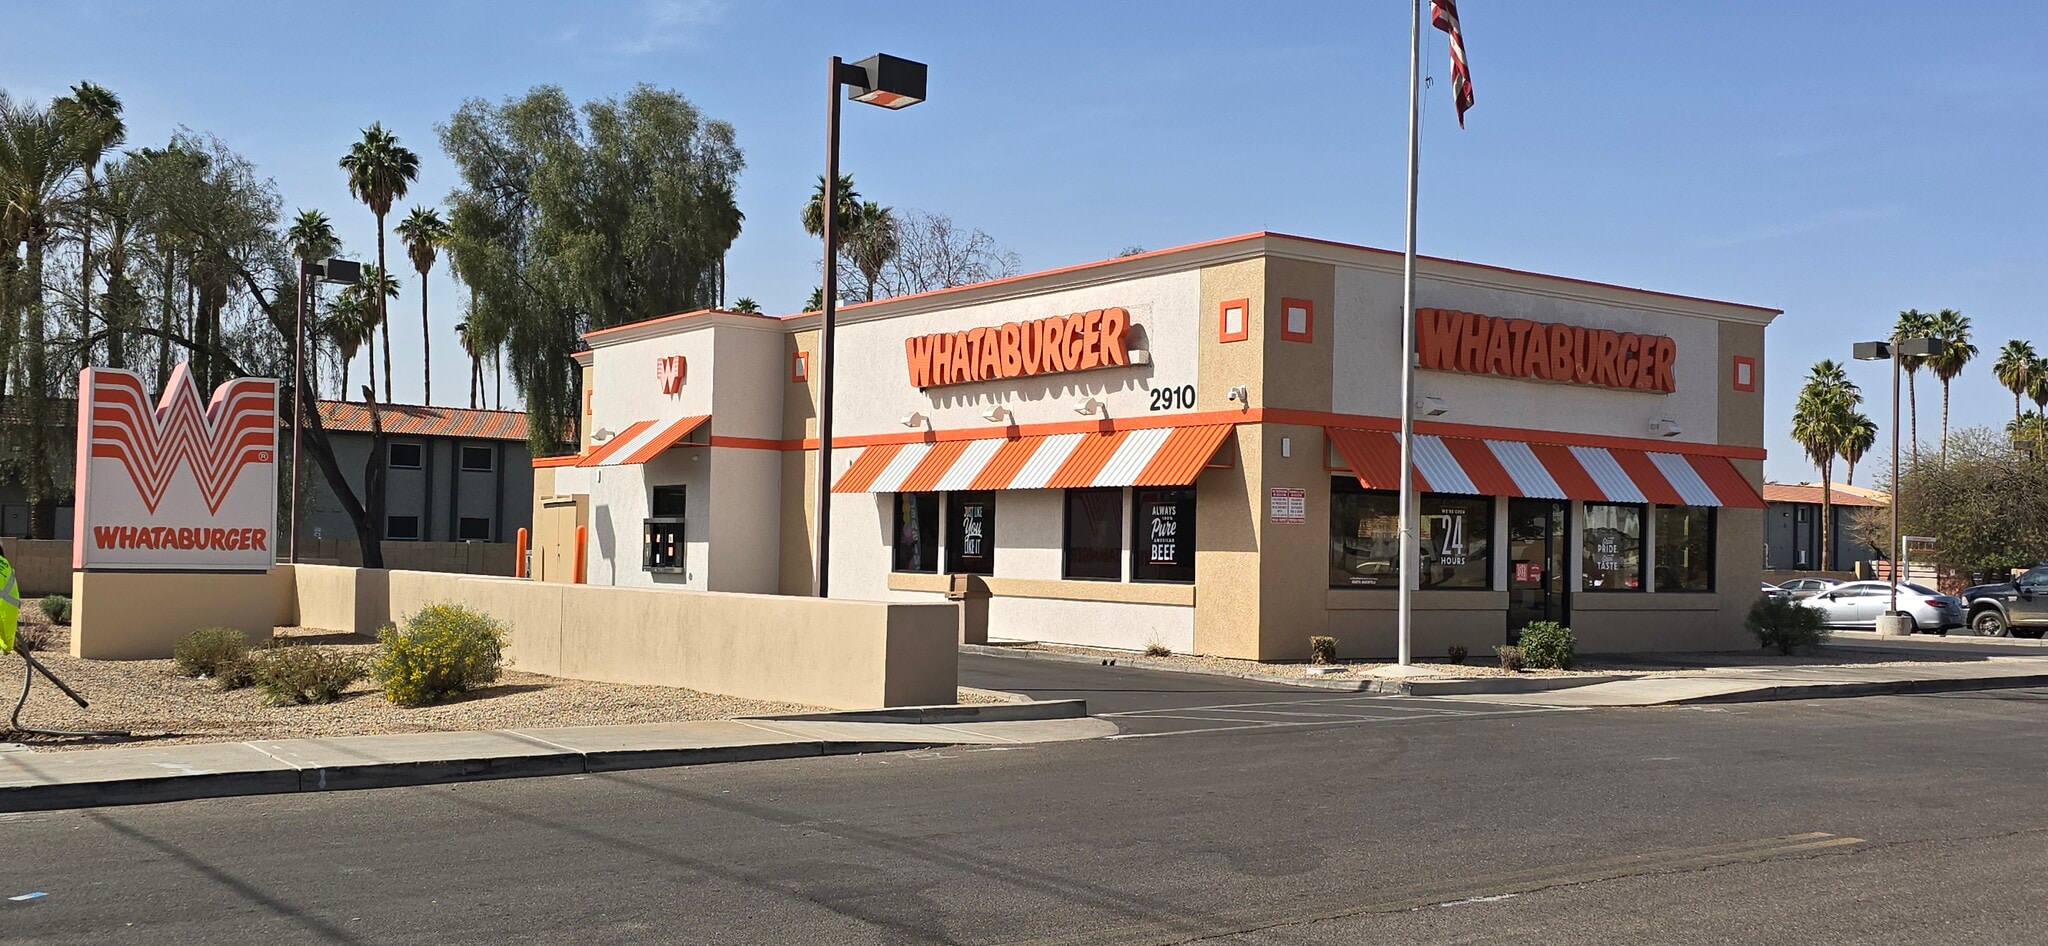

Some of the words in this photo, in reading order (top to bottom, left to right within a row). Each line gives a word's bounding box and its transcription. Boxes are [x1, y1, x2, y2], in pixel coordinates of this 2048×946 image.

[905, 307, 1131, 388] WHATABURGER
[1415, 308, 1677, 394] WHATABURGER
[1150, 384, 1196, 411] 2910
[1151, 505, 1177, 516] ALWAYS
[93, 525, 267, 552] WHATABURGER
[963, 517, 983, 540] You
[1151, 517, 1177, 540] Pure
[1441, 514, 1463, 555] 24
[1151, 543, 1176, 561] BEEF
[1597, 544, 1619, 554] PRIDE.
[1440, 556, 1466, 566] HOURS
